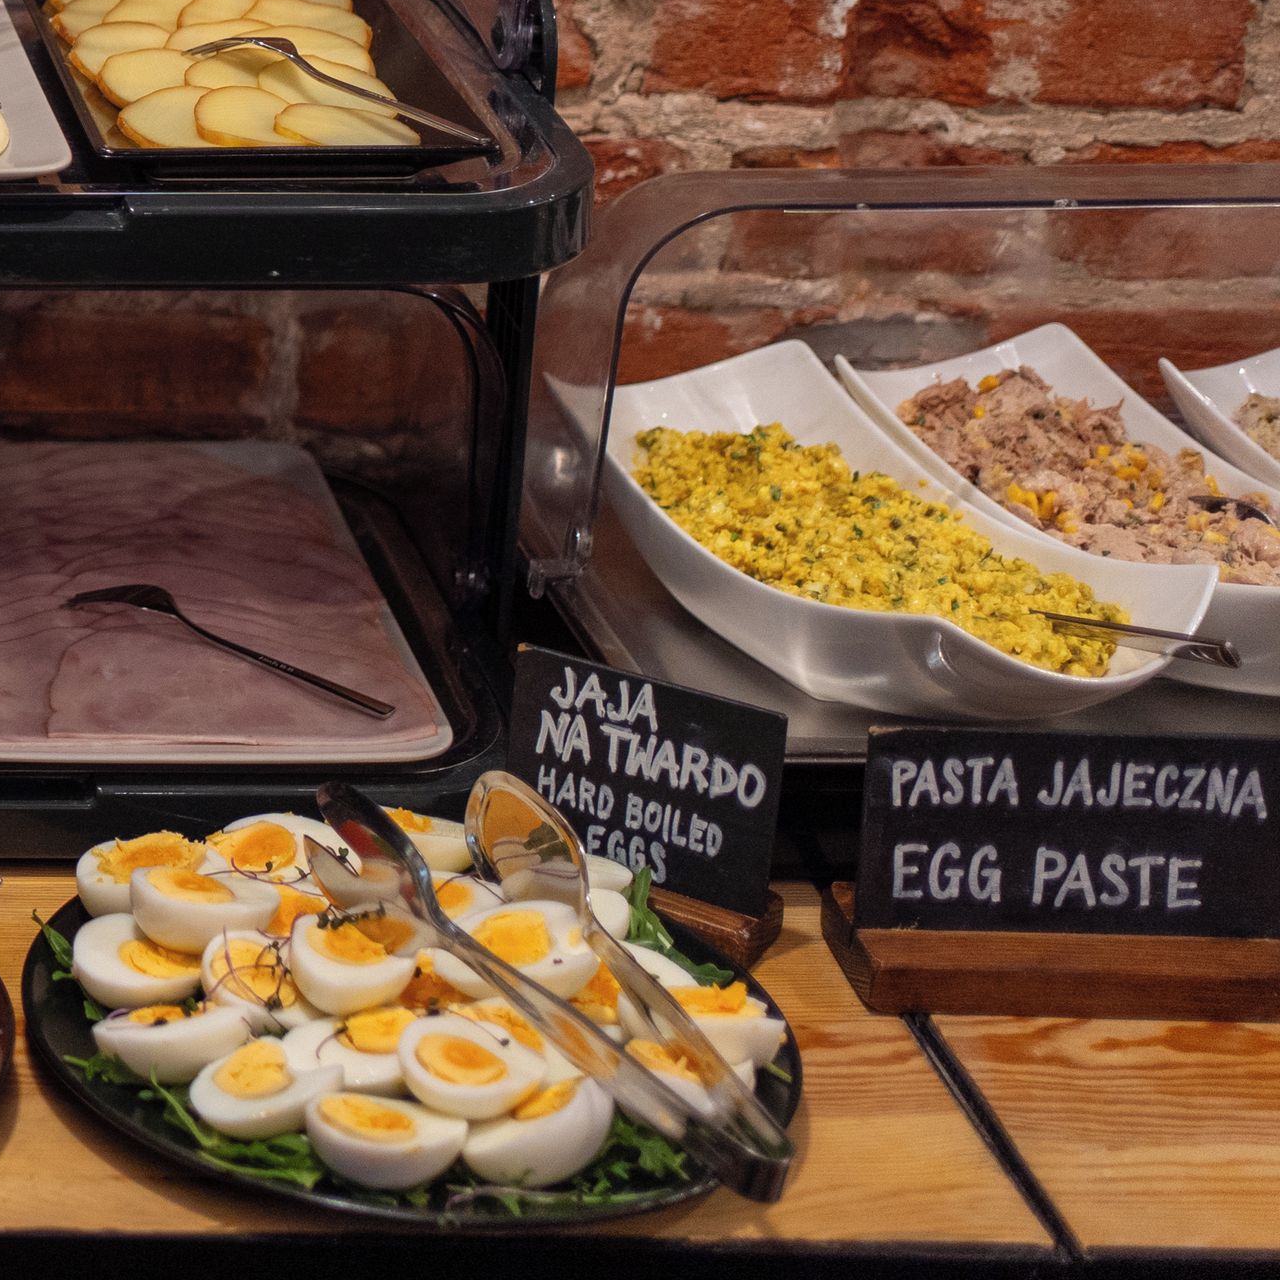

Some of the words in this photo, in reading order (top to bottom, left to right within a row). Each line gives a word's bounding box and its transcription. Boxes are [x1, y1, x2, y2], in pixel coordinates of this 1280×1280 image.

[549, 666, 658, 732] JAJA
[535, 709, 591, 766] NA
[600, 722, 767, 808] TWARDO
[891, 757, 1020, 808] PASTA
[1037, 758, 1268, 820] JAJECZNA
[537, 764, 615, 820] HARD
[625, 792, 723, 857] BOILED
[892, 841, 1002, 904] EGG
[1031, 846, 1203, 909] PASTE
